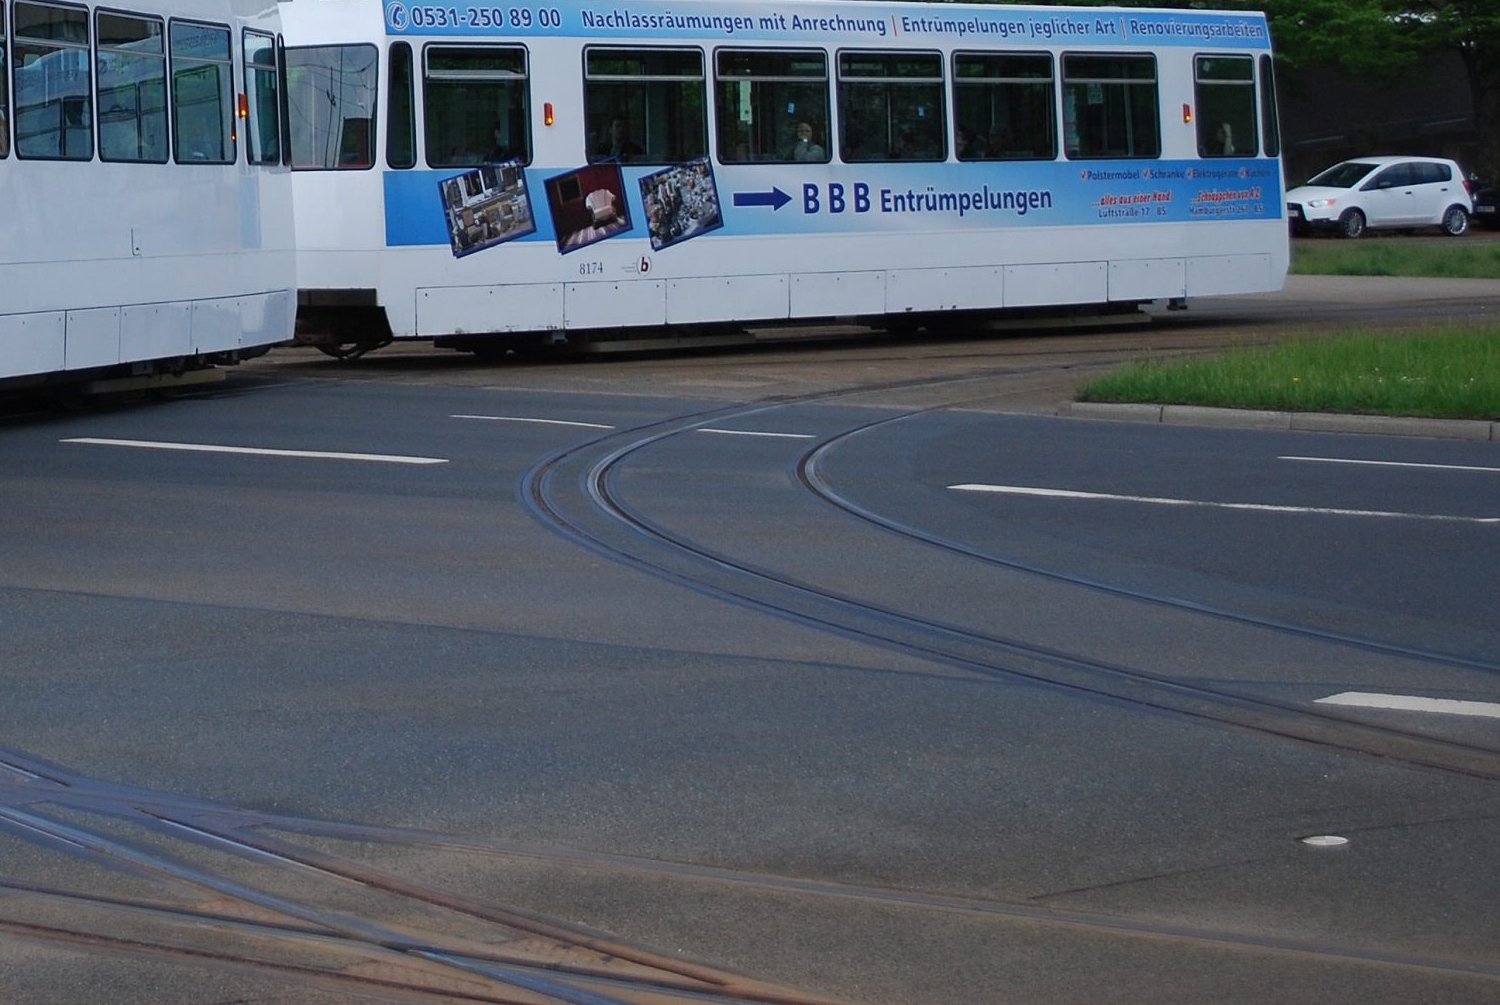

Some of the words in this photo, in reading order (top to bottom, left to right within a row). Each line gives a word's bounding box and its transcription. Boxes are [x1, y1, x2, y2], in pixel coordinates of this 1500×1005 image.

[411, 6, 504, 28] 0531-250
[509, 7, 533, 28] 89
[538, 7, 561, 28] 00
[581, 9, 753, 34] Nachlassräumungen
[759, 13, 786, 31] mit
[792, 14, 887, 36] Anrechnung
[901, 16, 1026, 37] Entrümpelungen
[1028, 18, 1091, 38] jeglicher
[1094, 19, 1117, 36] Art
[1130, 20, 1264, 40] Renovierungsarbeiten
[880, 185, 1053, 217] Entrümpelungen
[1098, 207, 1139, 218] Luftstraße
[579, 261, 603, 275] 8174
